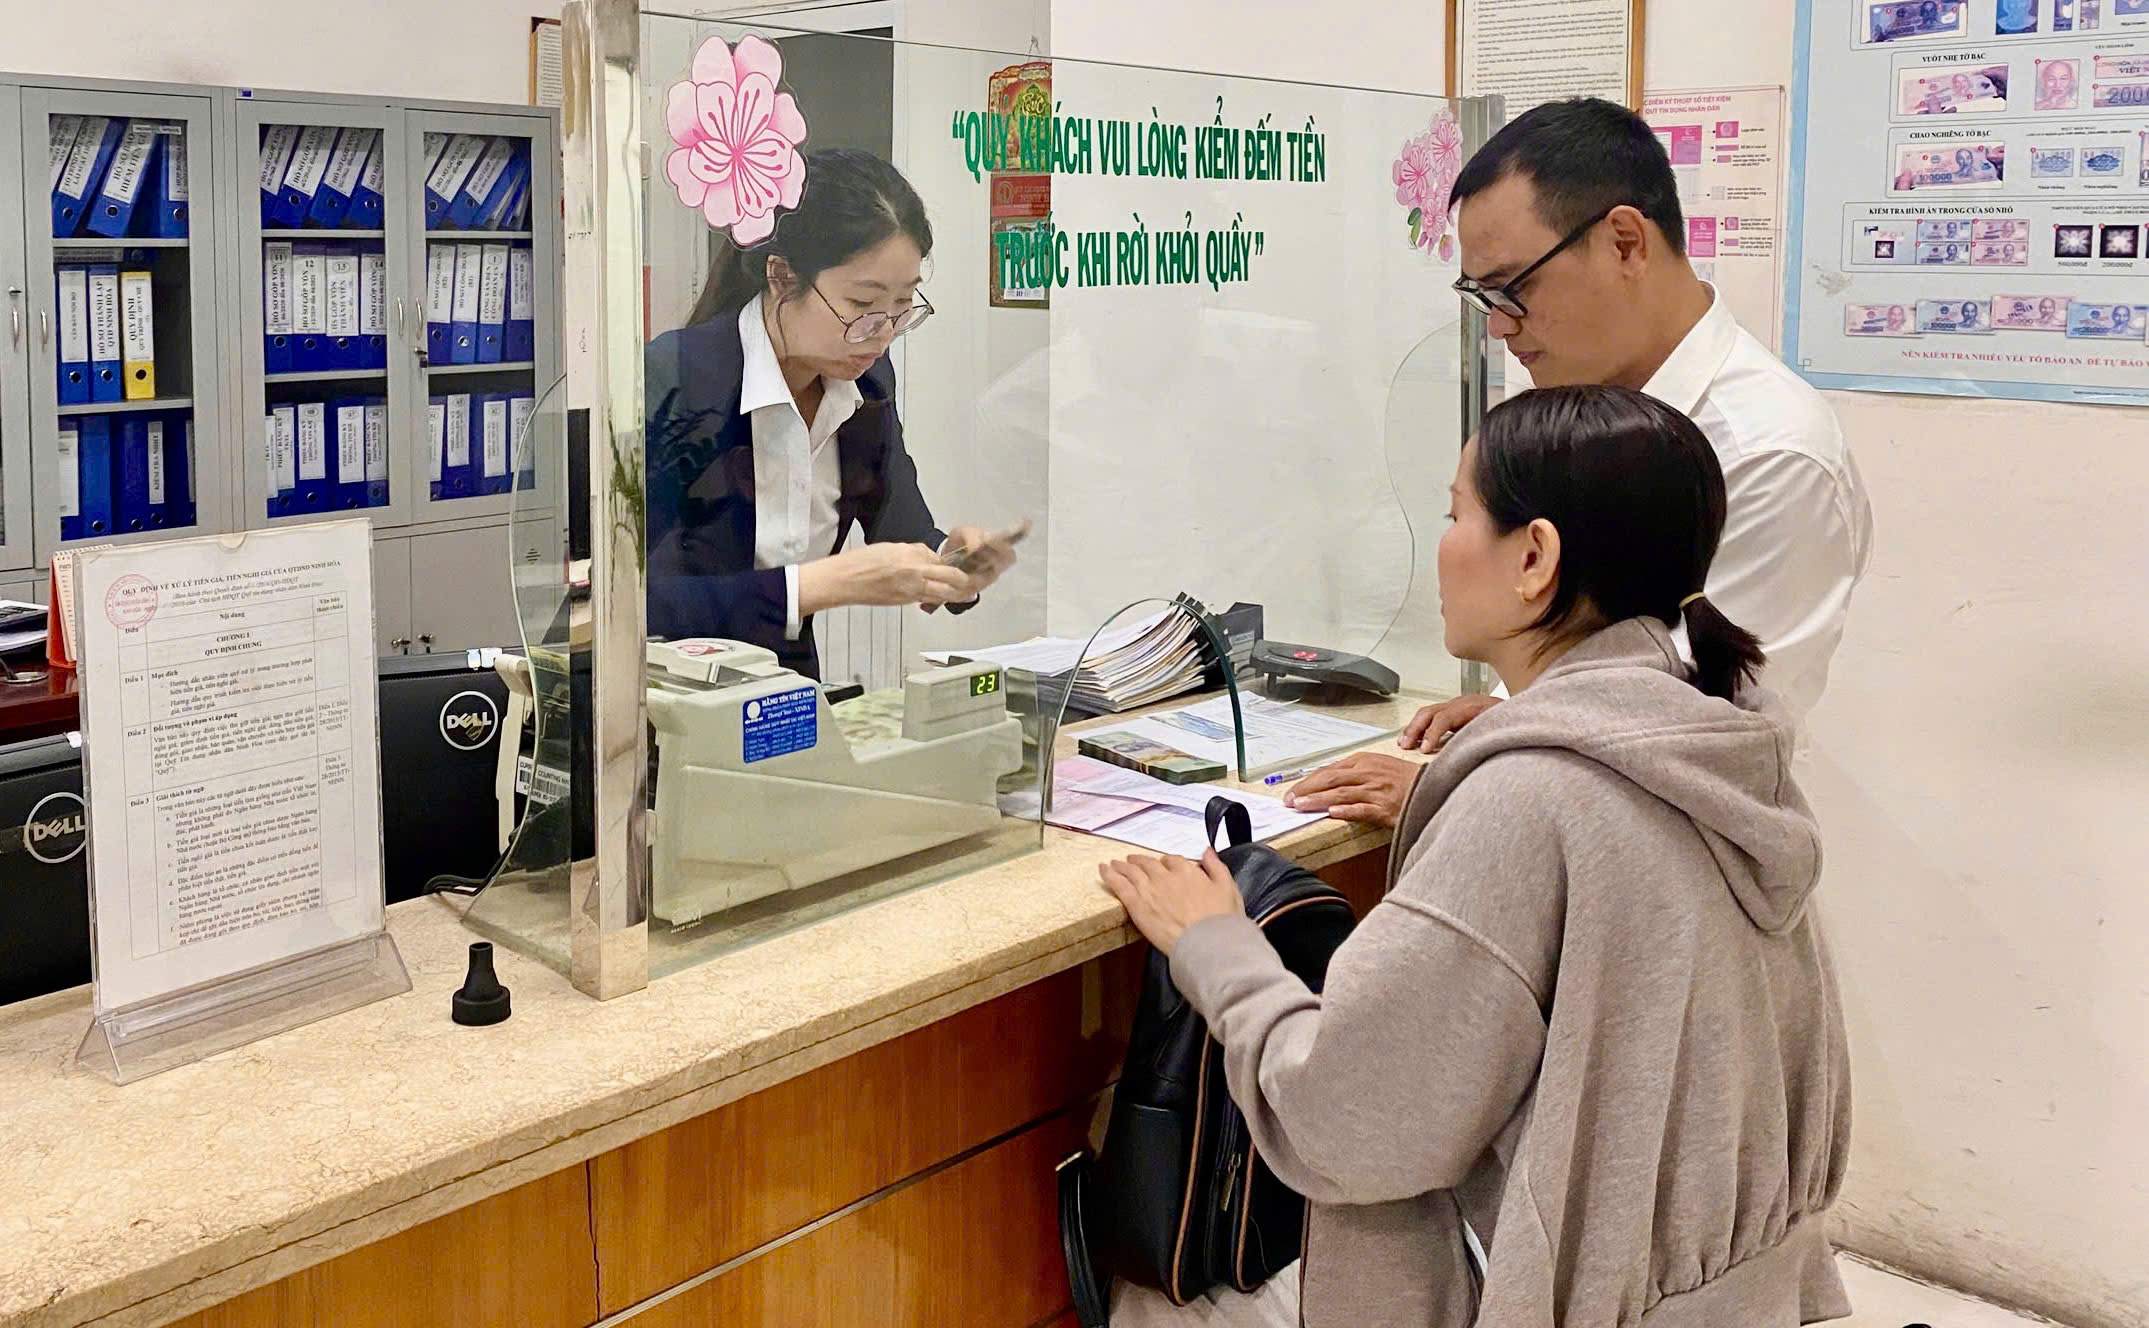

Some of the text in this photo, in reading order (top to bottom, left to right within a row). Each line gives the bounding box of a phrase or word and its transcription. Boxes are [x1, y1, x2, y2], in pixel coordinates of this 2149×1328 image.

[1019, 101, 1092, 174] KHÁCH
[1098, 120, 1130, 176] VUI
[1138, 106, 1187, 180] LÒNG
[1194, 95, 1240, 180] KIỂM
[1243, 113, 1282, 182] ĐẾM
[1286, 114, 1326, 183] TIỀN
[993, 209, 1069, 289] TRƯỚC
[1077, 232, 1111, 288] KHI
[1116, 212, 1149, 286] RỜI
[1155, 211, 1199, 284] KHỎI
[204, 640, 261, 656] QUY ĐỊNH CHUNG
[977, 673, 996, 694] 23
[446, 712, 492, 729] DELL
[34, 816, 85, 841] DELL
